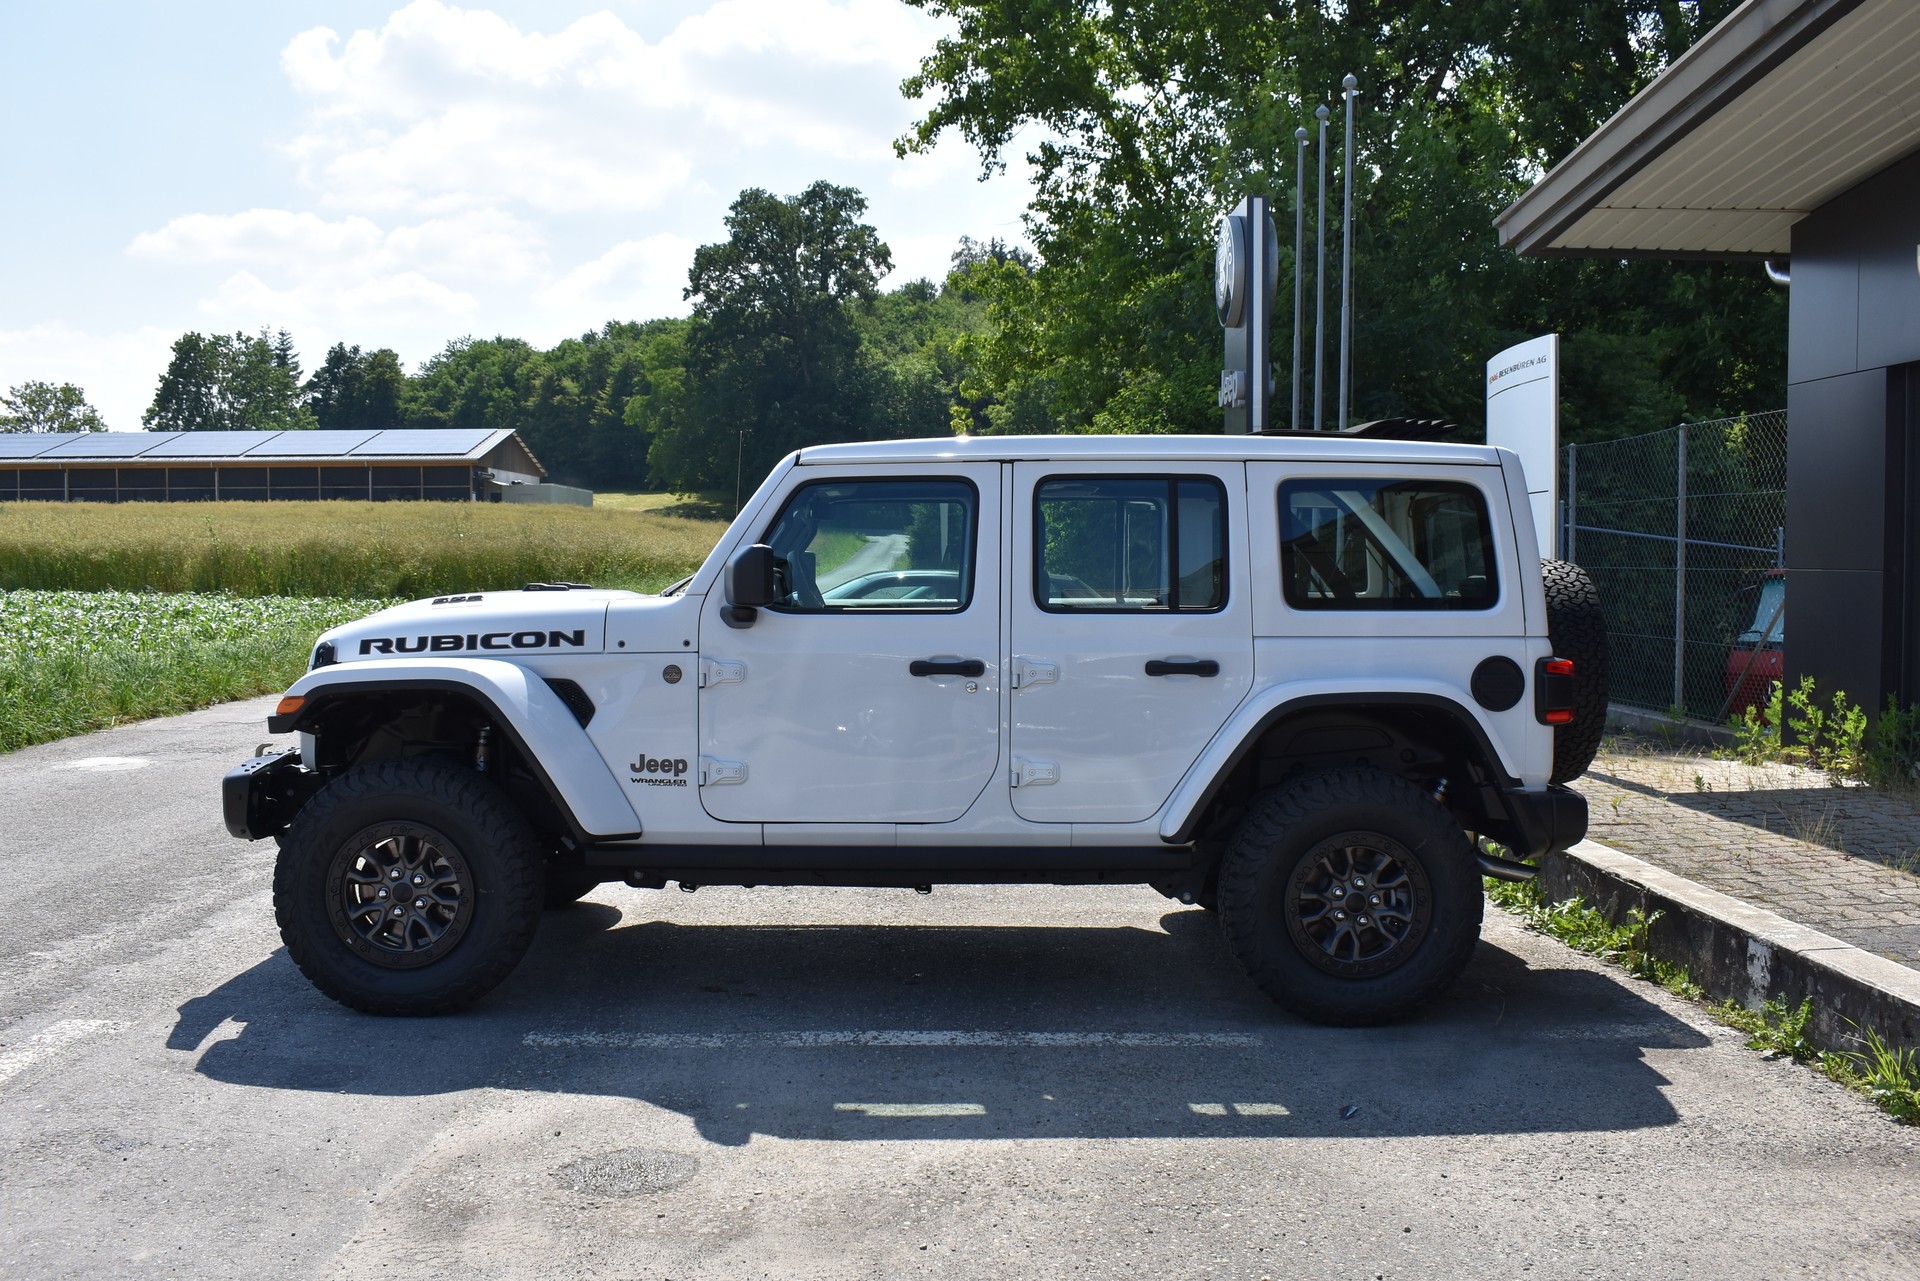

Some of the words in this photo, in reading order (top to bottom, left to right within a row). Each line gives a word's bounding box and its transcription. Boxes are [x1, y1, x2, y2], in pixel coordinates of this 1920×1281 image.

[1499, 358, 1535, 378] BESENBÜREN
[1536, 355, 1547, 365] AG
[1218, 370, 1238, 408] Jeep
[359, 630, 585, 655] RUBICON
[630, 754, 688, 777] Jeep
